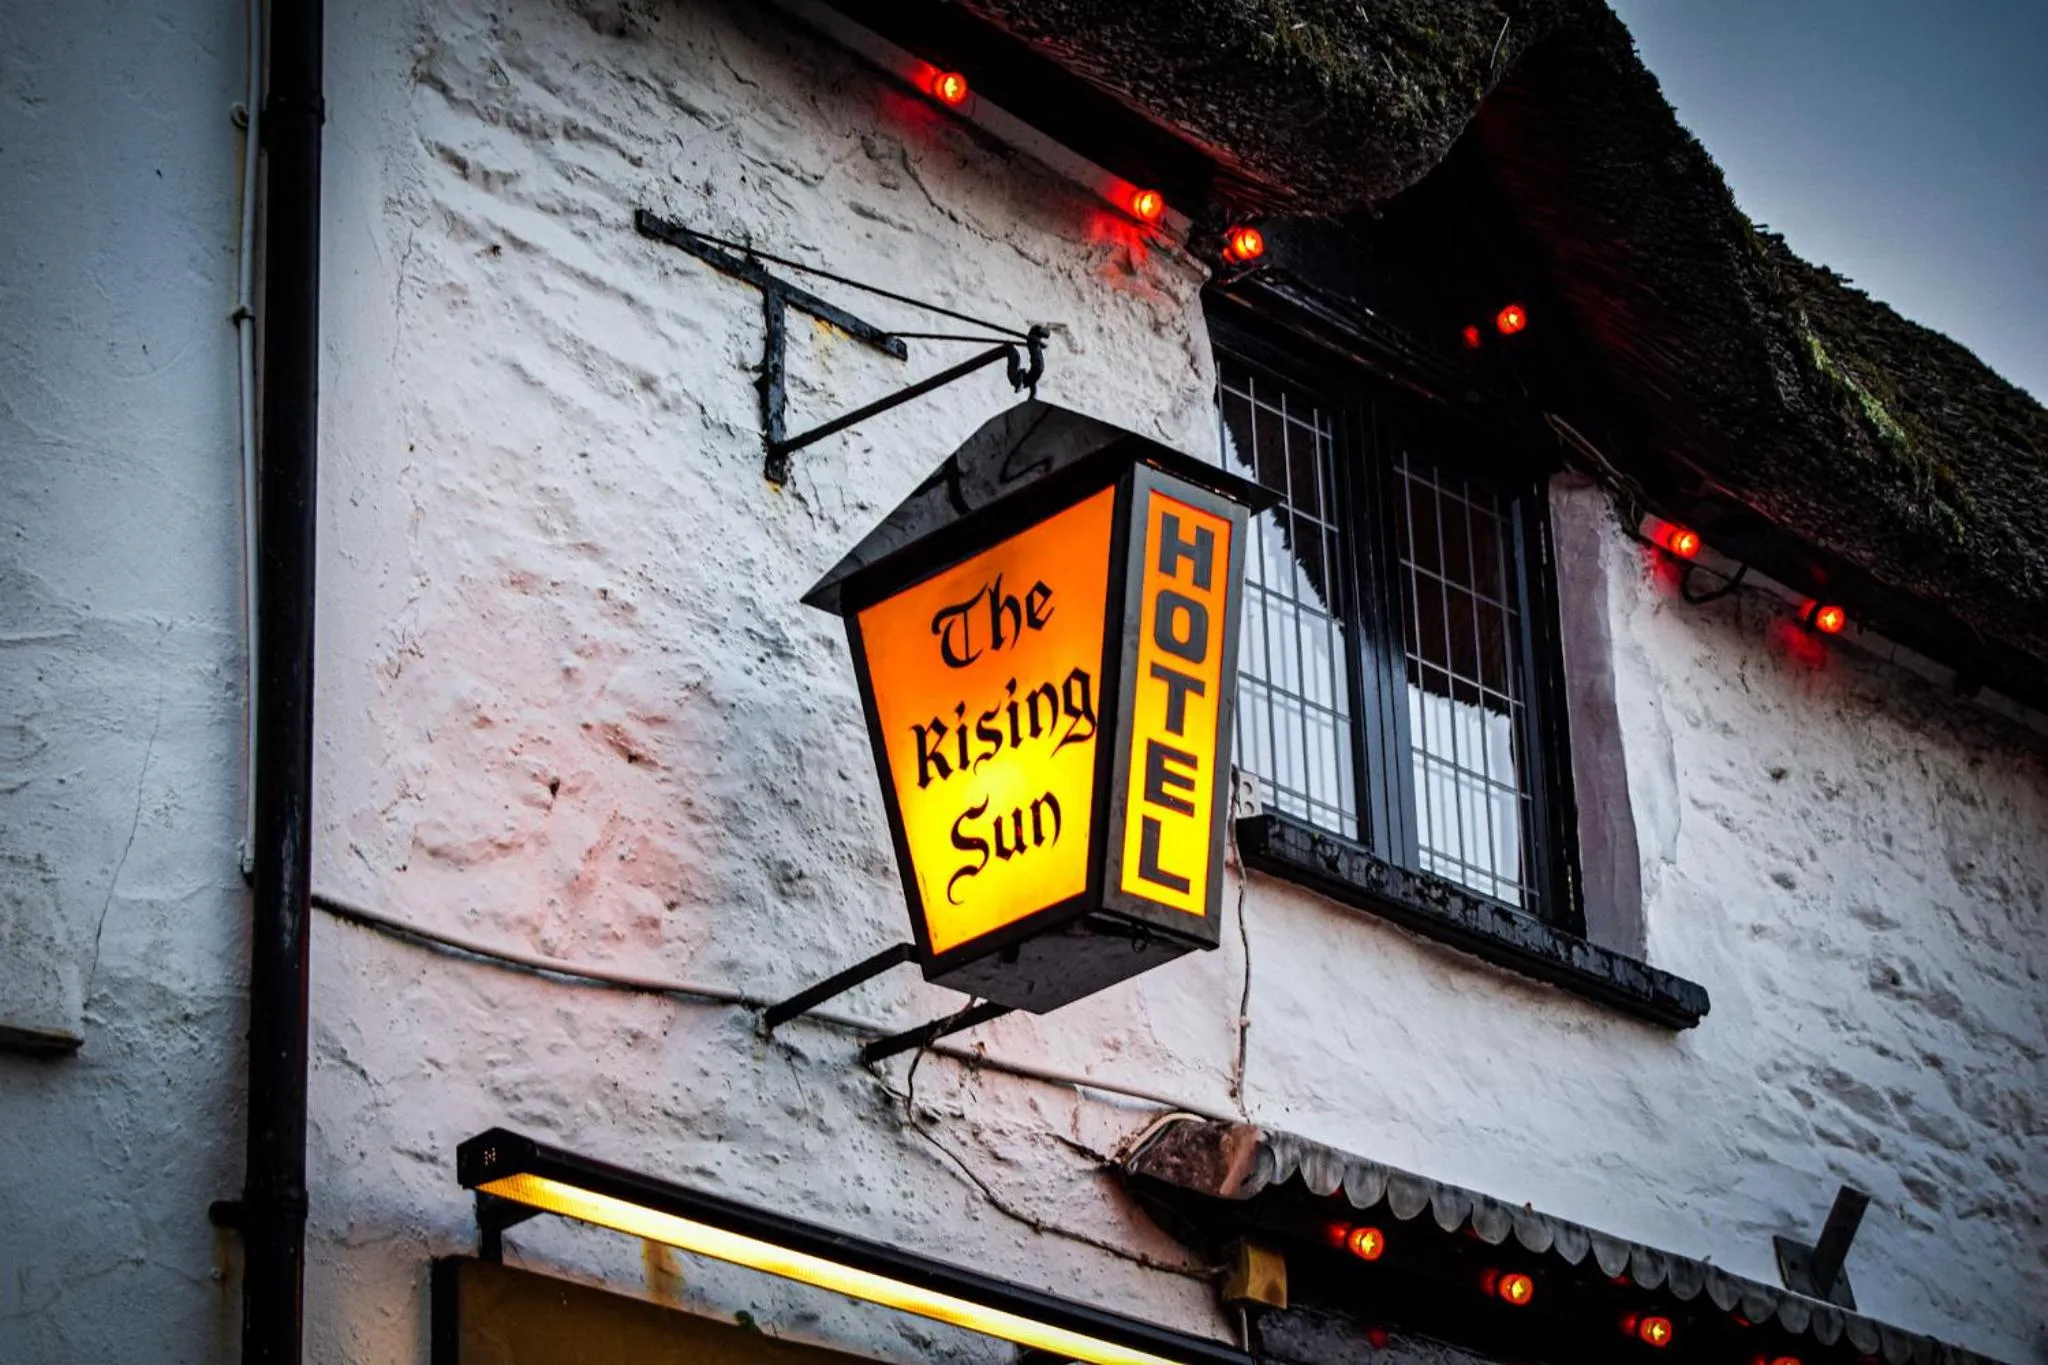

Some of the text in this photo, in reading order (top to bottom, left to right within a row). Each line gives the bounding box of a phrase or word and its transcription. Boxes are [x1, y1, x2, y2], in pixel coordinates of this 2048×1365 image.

[931, 572, 1055, 669] The
[908, 666, 1098, 790] Rising
[1138, 513, 1215, 895] HOTEL
[946, 790, 1062, 906] Sun
